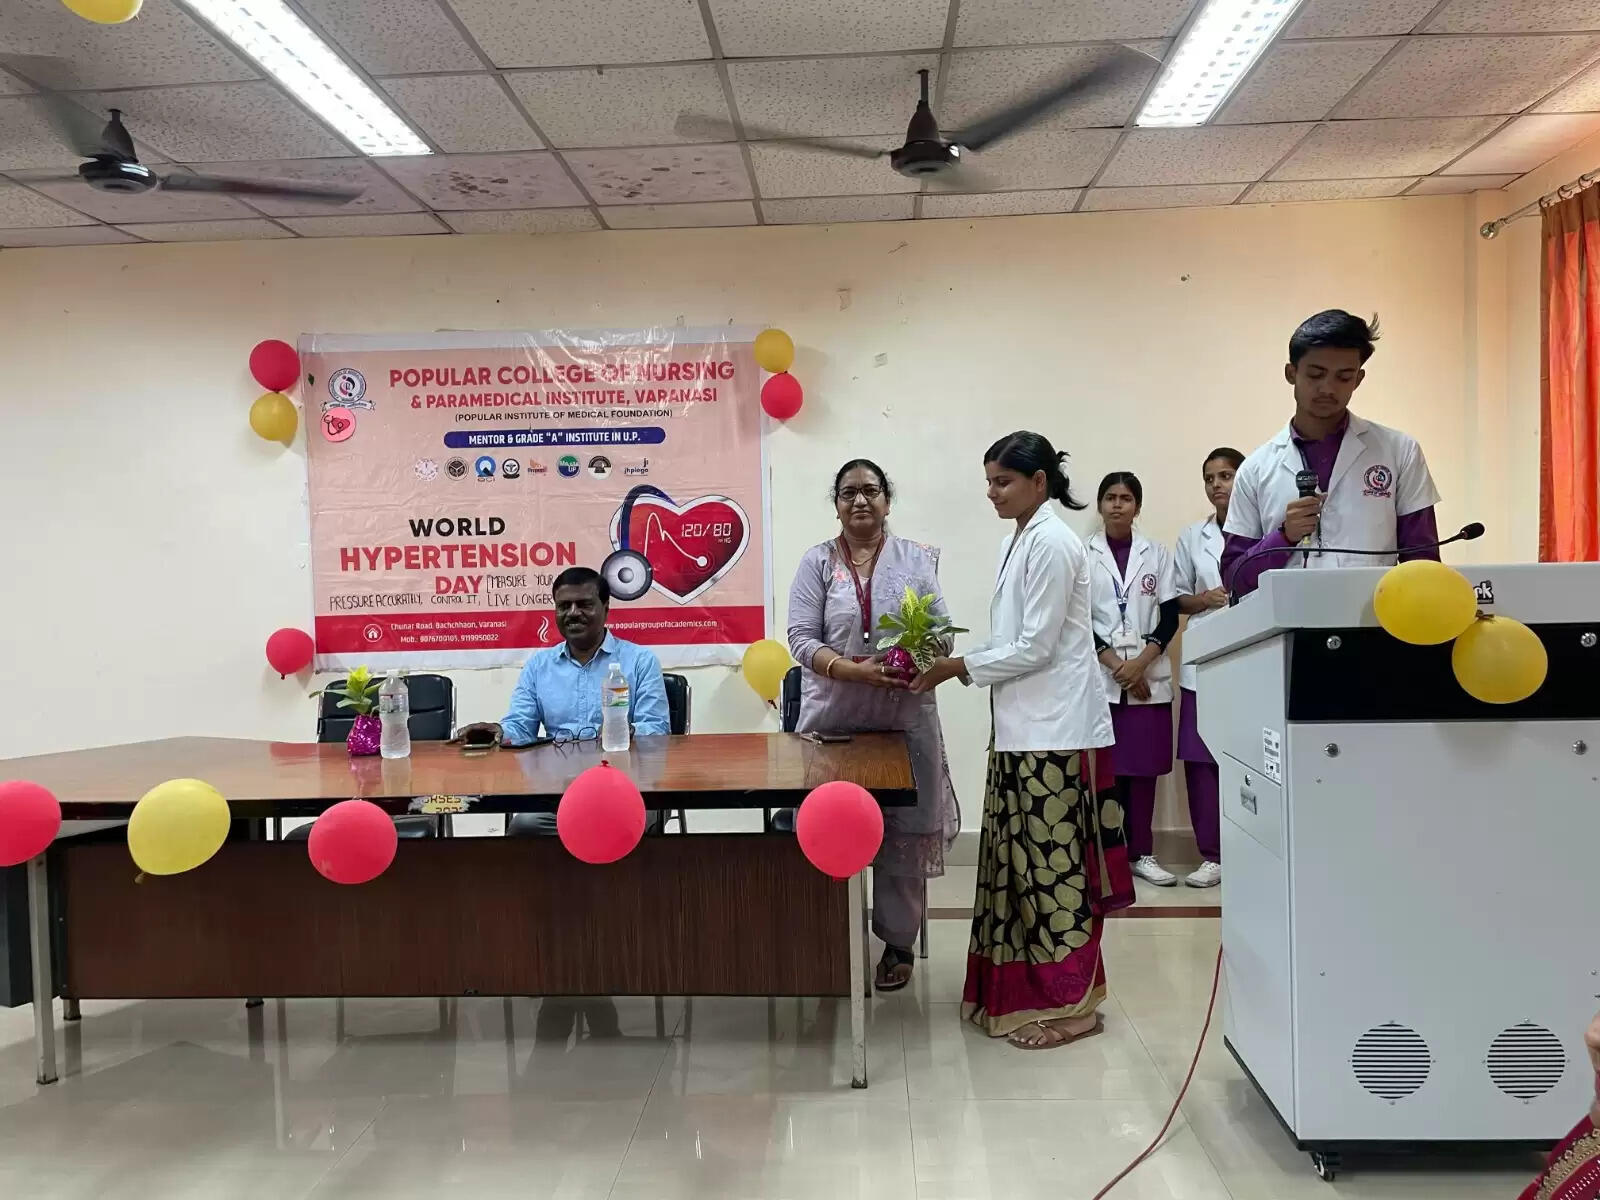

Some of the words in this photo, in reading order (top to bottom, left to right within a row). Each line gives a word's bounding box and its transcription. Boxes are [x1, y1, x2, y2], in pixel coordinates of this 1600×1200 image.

[390, 366, 491, 387] POPULAR
[497, 364, 595, 385] COLLEGE
[601, 363, 631, 382] OF
[636, 361, 735, 382] NURSING
[410, 395, 421, 409] &
[426, 391, 542, 408] PARAMEDICAL
[546, 389, 630, 405] INSTITUTE,
[635, 387, 717, 404] VARANASI
[455, 413, 502, 422] (POPULAR
[504, 411, 550, 420] INSTITUTE
[552, 411, 565, 419] OF
[568, 410, 609, 419] MEDICAL
[611, 409, 673, 418] FOUNDATION)
[468, 434, 507, 445] MENTOR
[507, 434, 514, 443] &
[515, 433, 544, 443] GRADE
[565, 432, 610, 443] INSTITUTE
[611, 432, 621, 442] IN
[623, 432, 641, 442] U.P.
[409, 517, 506, 537] WORLD
[340, 541, 577, 571] HYPERTENSION
[435, 575, 484, 595] DAY
[533, 574, 554, 587] YOUR
[329, 594, 374, 612] PRESSURE
[431, 594, 463, 605] CONTROL
[487, 593, 510, 607] LIVE
[515, 593, 554, 607] LONGER
[479, 620, 507, 628] Varanasi
